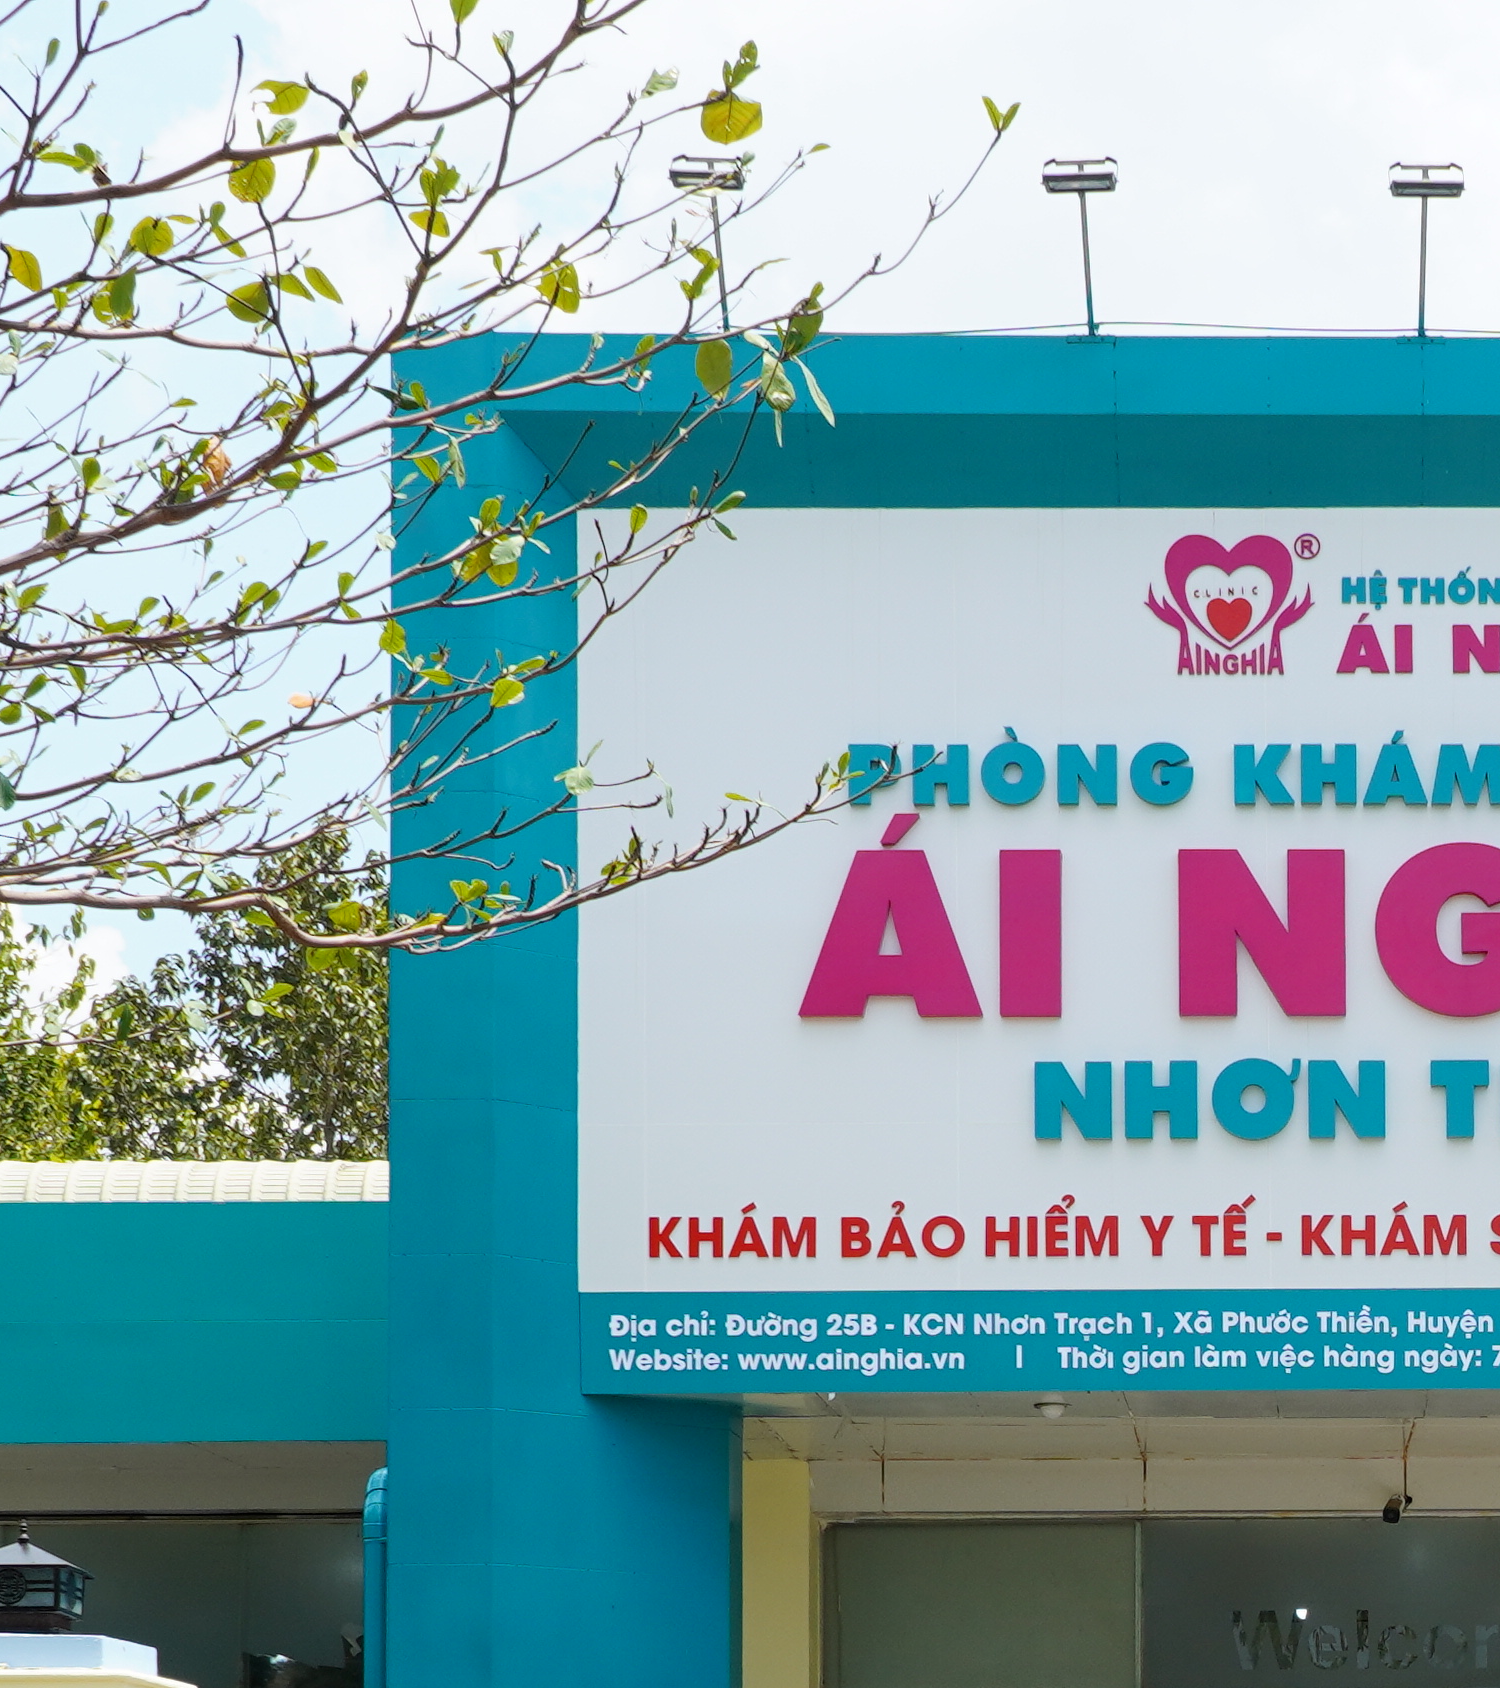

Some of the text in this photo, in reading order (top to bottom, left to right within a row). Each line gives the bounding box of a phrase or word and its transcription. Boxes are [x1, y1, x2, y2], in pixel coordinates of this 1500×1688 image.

[1193, 586, 1259, 598] CLINIC
[1341, 569, 1387, 610] HỆ
[1177, 642, 1284, 675] AINGHIA
[1336, 612, 1412, 673] ÁI
[847, 726, 1194, 806] PHÒNG
[799, 813, 1061, 1018] ÁI
[1033, 1056, 1386, 1140] NHƠN
[648, 1202, 816, 1258] KHÁM
[842, 1200, 965, 1258] BẢO
[986, 1195, 1118, 1257] HIỂM
[1141, 1216, 1173, 1256] Y
[1192, 1195, 1256, 1256] TẾ
[1301, 1201, 1466, 1256] KHÁM
[609, 1314, 656, 1343] Địa
[665, 1310, 716, 1337] chỉ:
[726, 1311, 817, 1342] Đường
[827, 1314, 878, 1336] 25B
[903, 1313, 965, 1336] KCN
[974, 1313, 1045, 1335] Nhơn
[1055, 1311, 1133, 1342] Trạch
[1142, 1312, 1164, 1338] 1,
[1173, 1309, 1213, 1335] Xã
[1222, 1309, 1309, 1334] Phước
[1317, 1304, 1398, 1337] Thiền,
[1407, 1310, 1493, 1339] Huyện
[609, 1346, 965, 1377] Website: www.ainghia.vn
[1057, 1344, 1114, 1369] Thời
[1123, 1344, 1185, 1375] gian
[1194, 1343, 1247, 1368] làm
[1256, 1344, 1315, 1374] việc
[1324, 1343, 1395, 1374] hàng
[1405, 1343, 1482, 1374] ngày:
